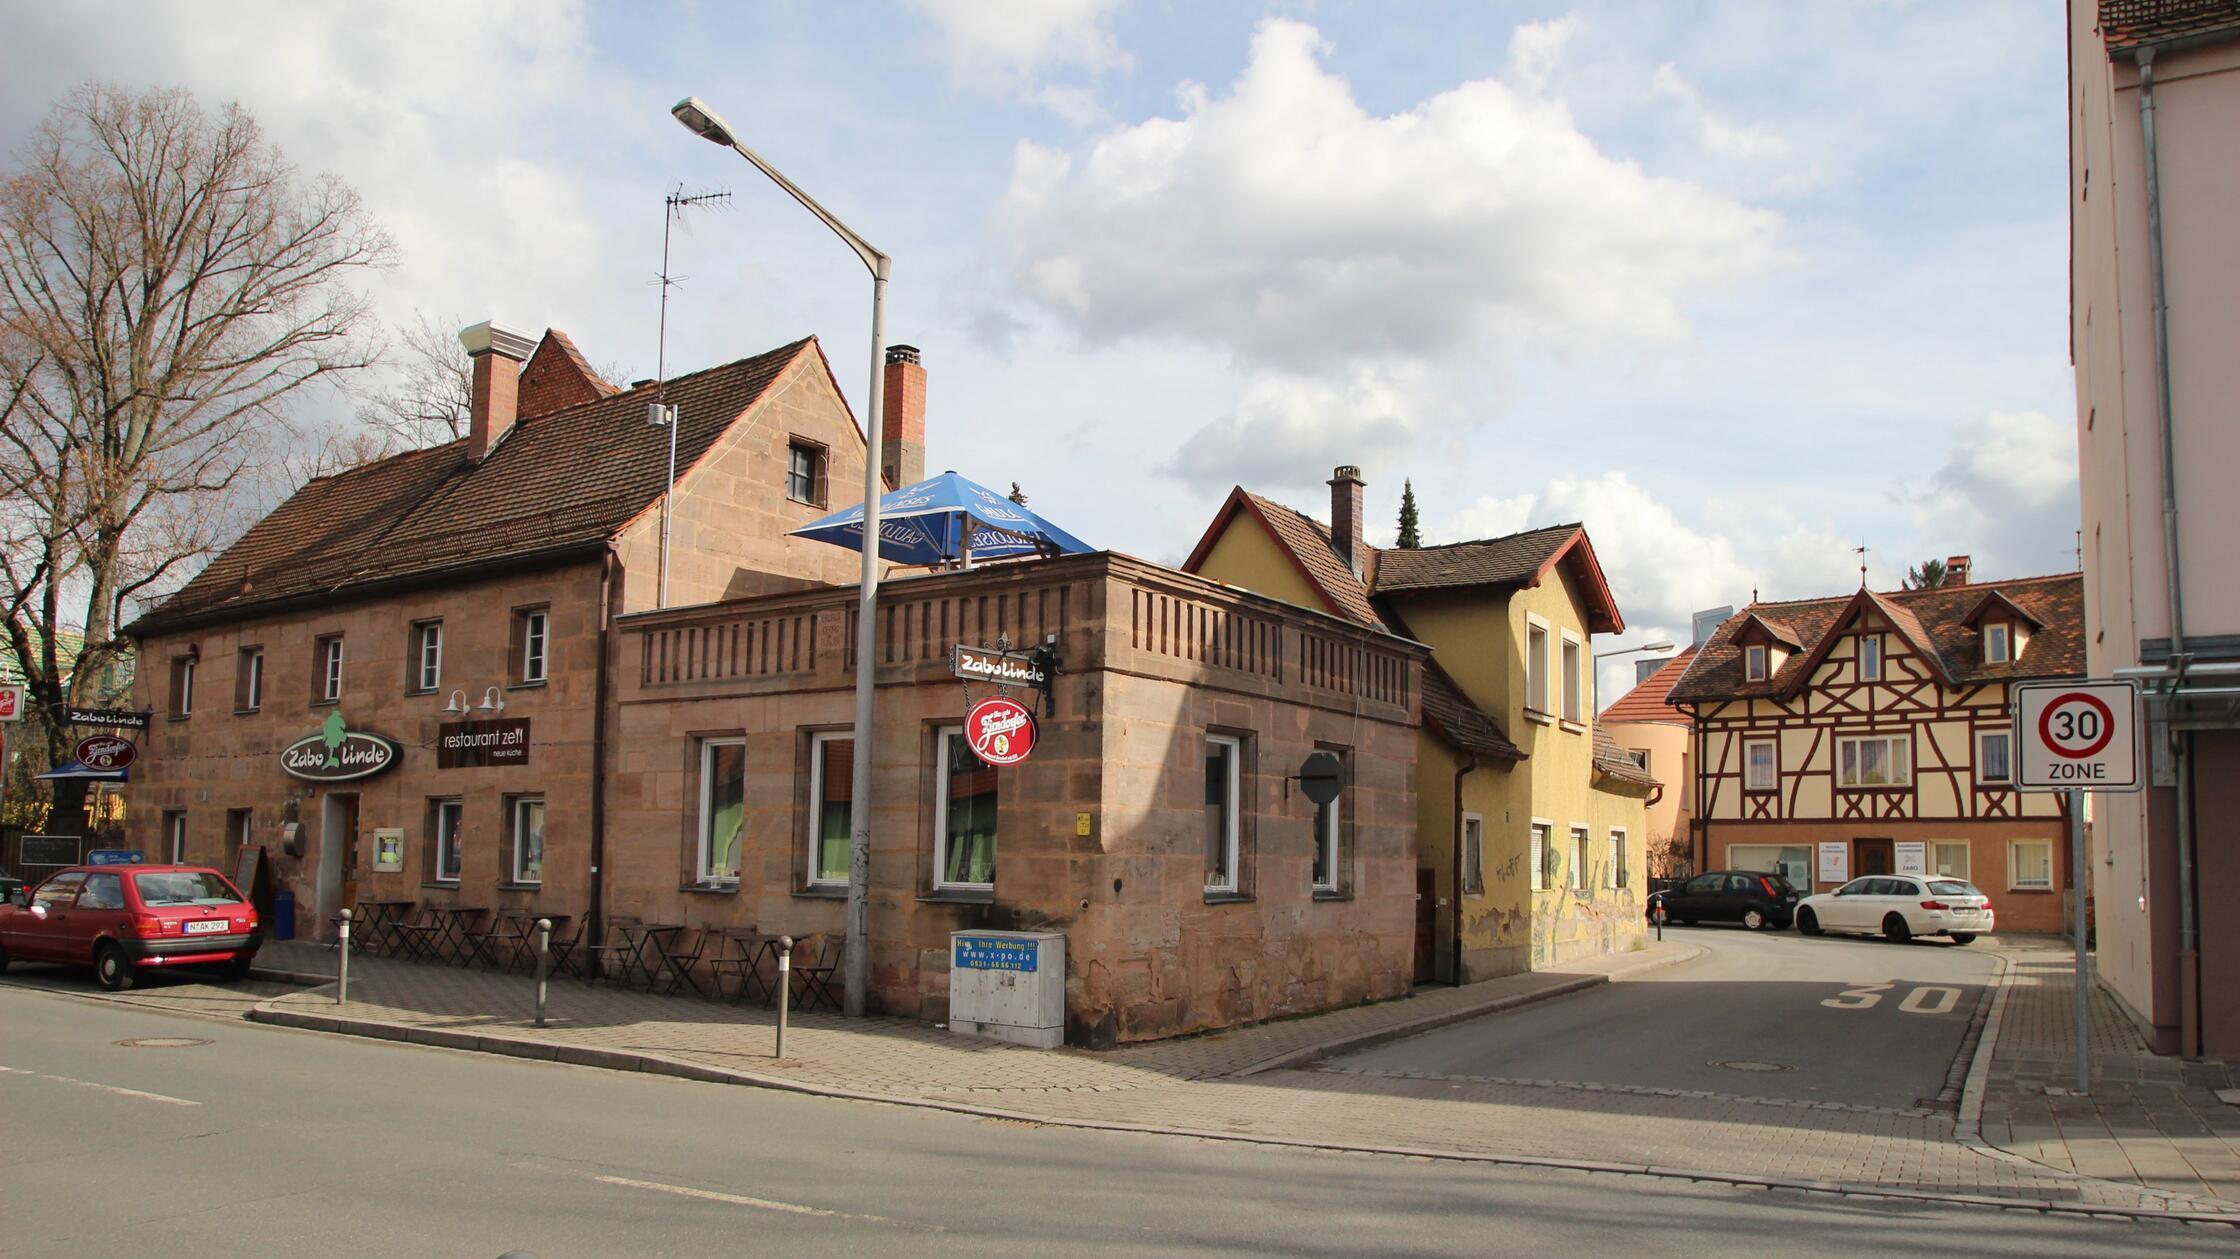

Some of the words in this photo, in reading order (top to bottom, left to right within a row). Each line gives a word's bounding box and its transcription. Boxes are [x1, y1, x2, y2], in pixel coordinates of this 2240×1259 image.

[2054, 710, 2098, 741] 30
[444, 729, 500, 748] restaurant
[289, 747, 324, 768] Zabo
[342, 743, 385, 765] Linde
[2048, 763, 2106, 779] ZONE
[200, 922, 209, 930] AK
[211, 921, 225, 930] 292
[978, 940, 993, 949] Ihre
[995, 941, 1025, 952] Werbung
[1820, 981, 1962, 1014] 30
